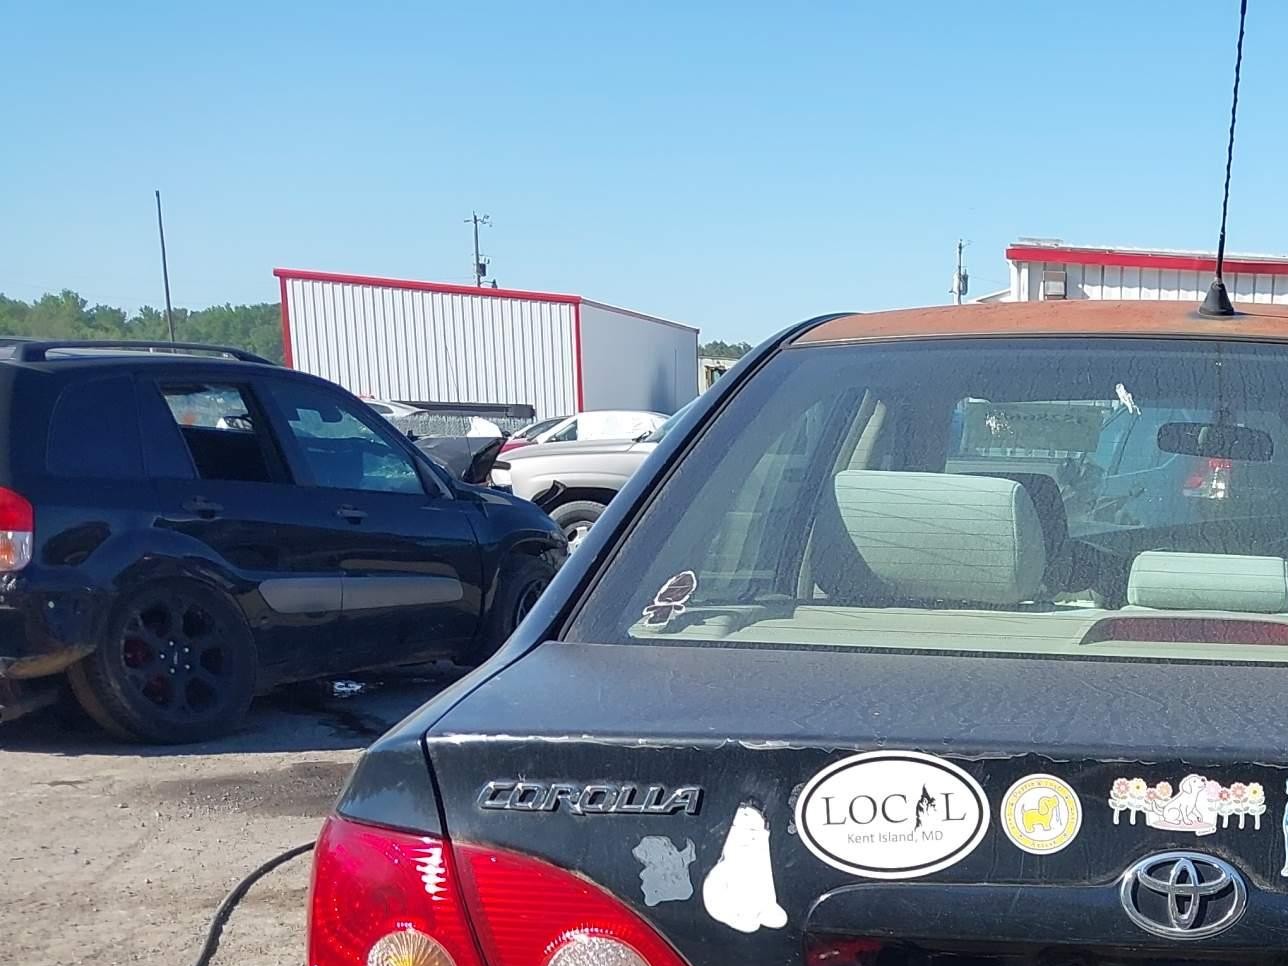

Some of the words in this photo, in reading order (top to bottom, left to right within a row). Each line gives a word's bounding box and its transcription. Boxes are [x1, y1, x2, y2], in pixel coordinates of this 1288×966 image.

[477, 781, 704, 815] COROLLA
[847, 833, 874, 844] Kent
[878, 831, 918, 844] Island,
[922, 830, 943, 841] MD
